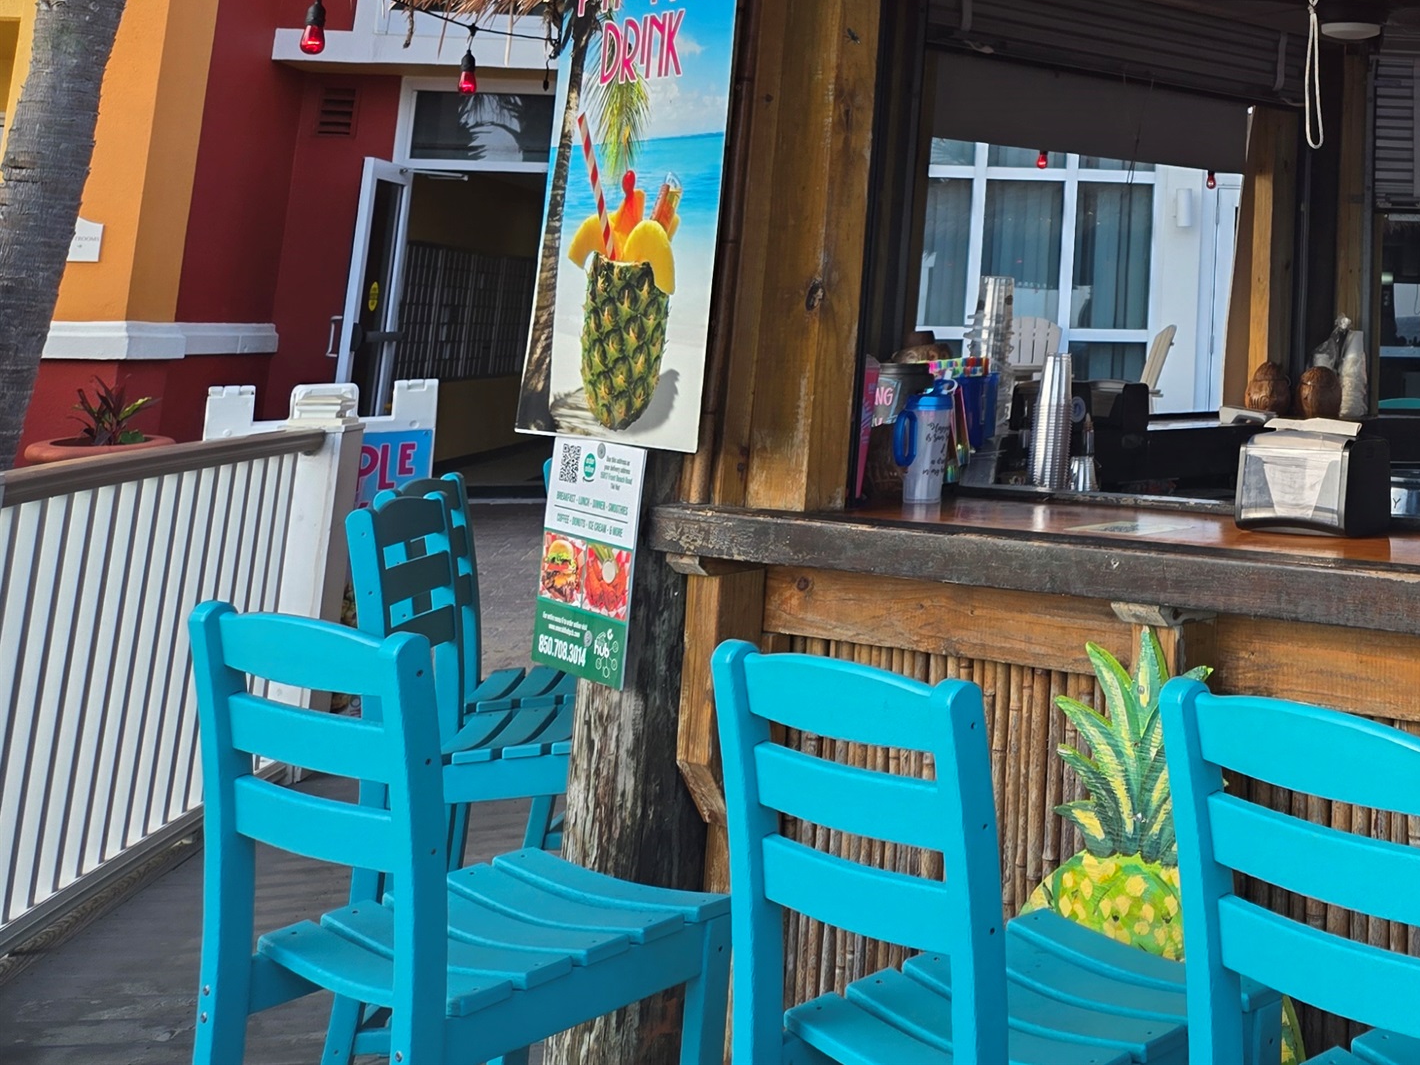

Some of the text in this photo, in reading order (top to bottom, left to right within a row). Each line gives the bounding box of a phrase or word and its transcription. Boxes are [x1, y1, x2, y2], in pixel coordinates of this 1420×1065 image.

[599, 8, 686, 86] DRINK
[538, 633, 610, 668] 850.708.3014 hub
